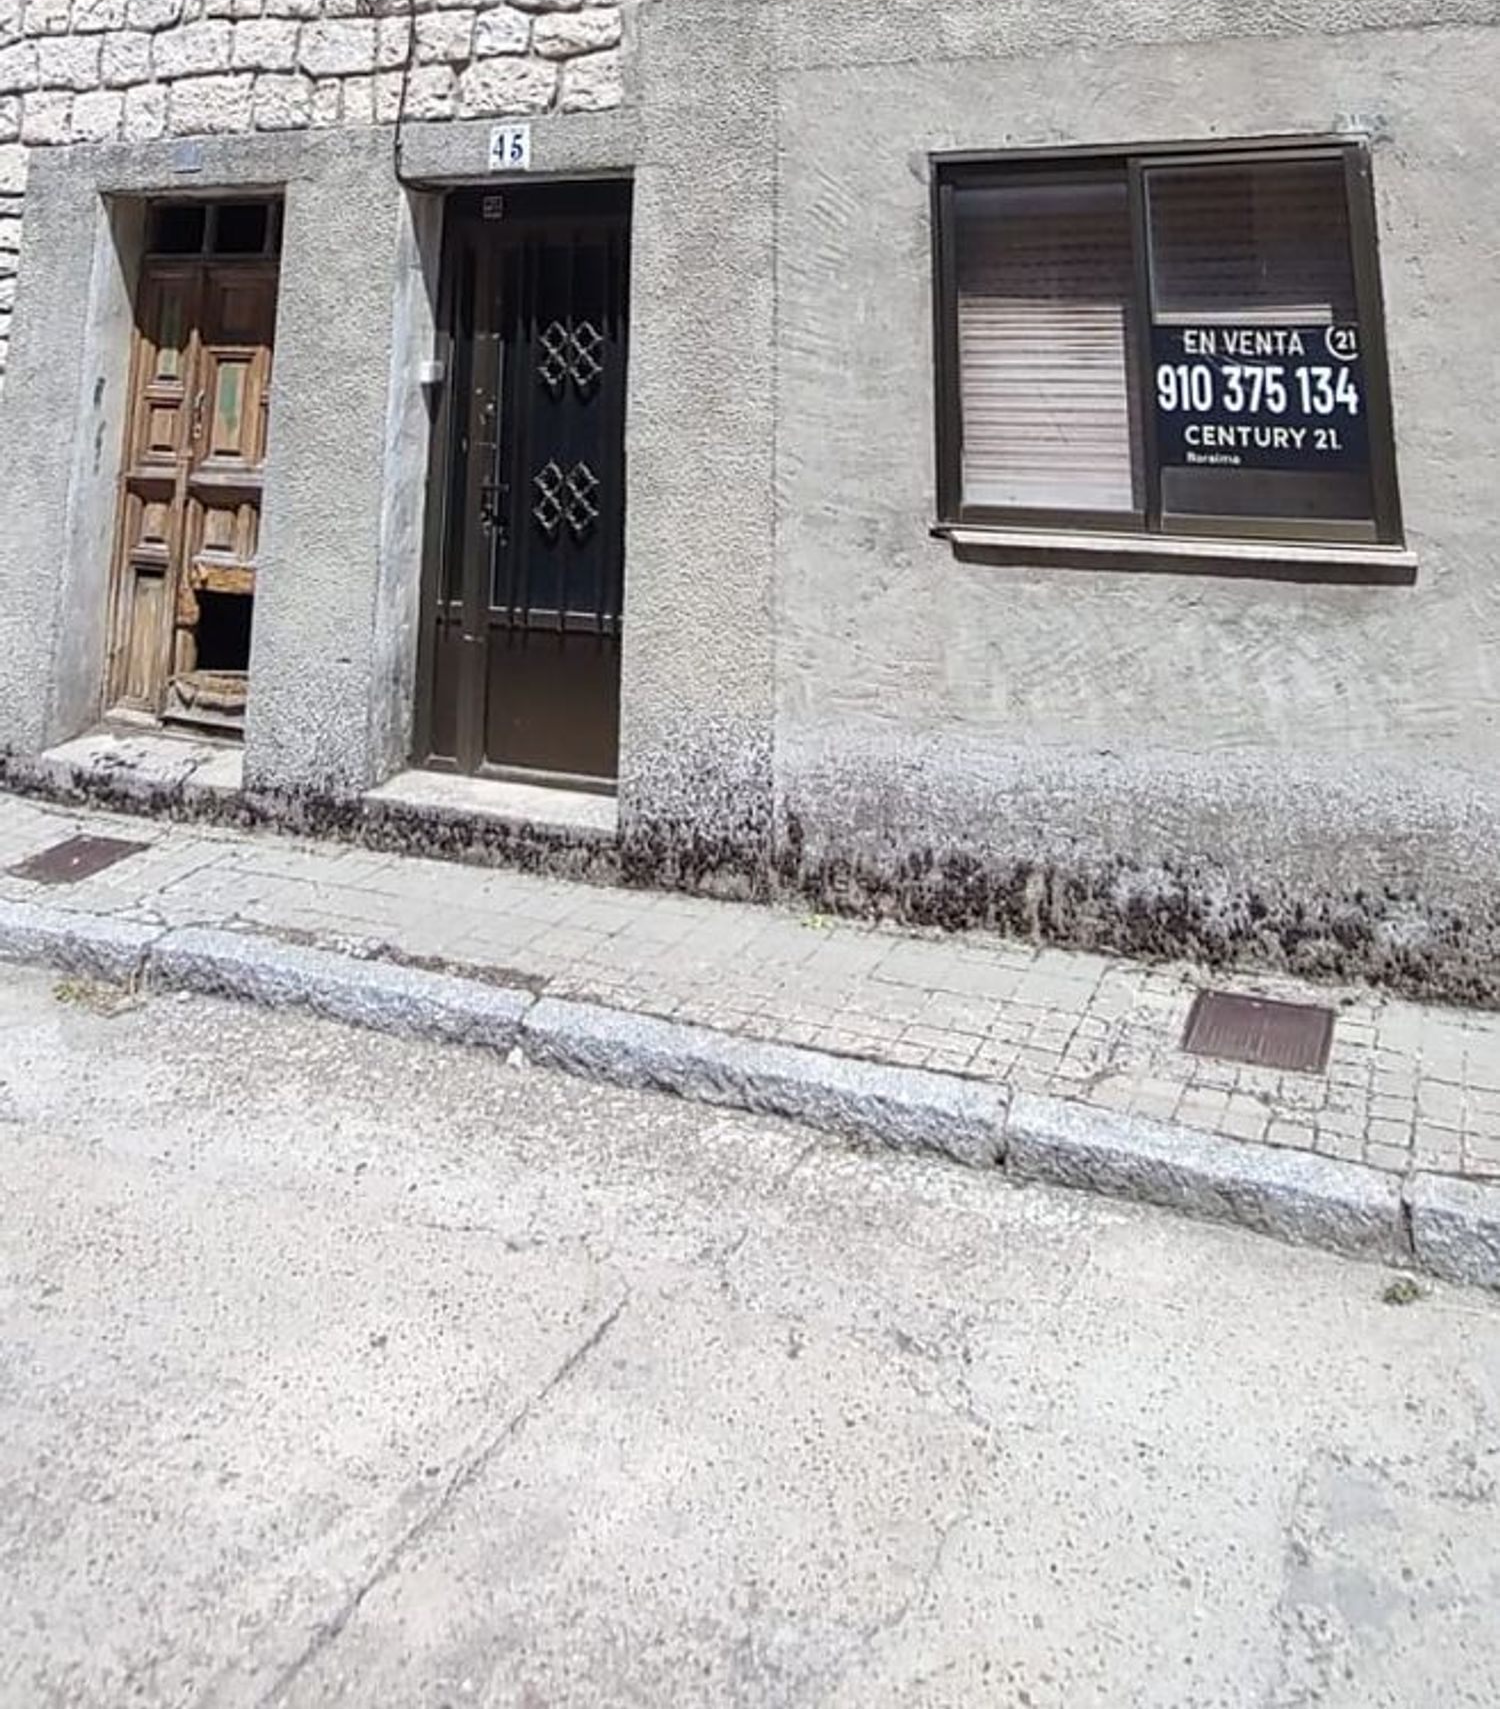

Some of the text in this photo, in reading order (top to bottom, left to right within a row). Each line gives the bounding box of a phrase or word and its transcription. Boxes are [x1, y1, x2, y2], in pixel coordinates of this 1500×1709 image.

[493, 134, 523, 161] 45
[1183, 330, 1305, 356] EN VENTA
[1334, 330, 1357, 351] 21
[1157, 364, 1359, 415] 910 375 134
[1184, 425, 1306, 448] CENTURY
